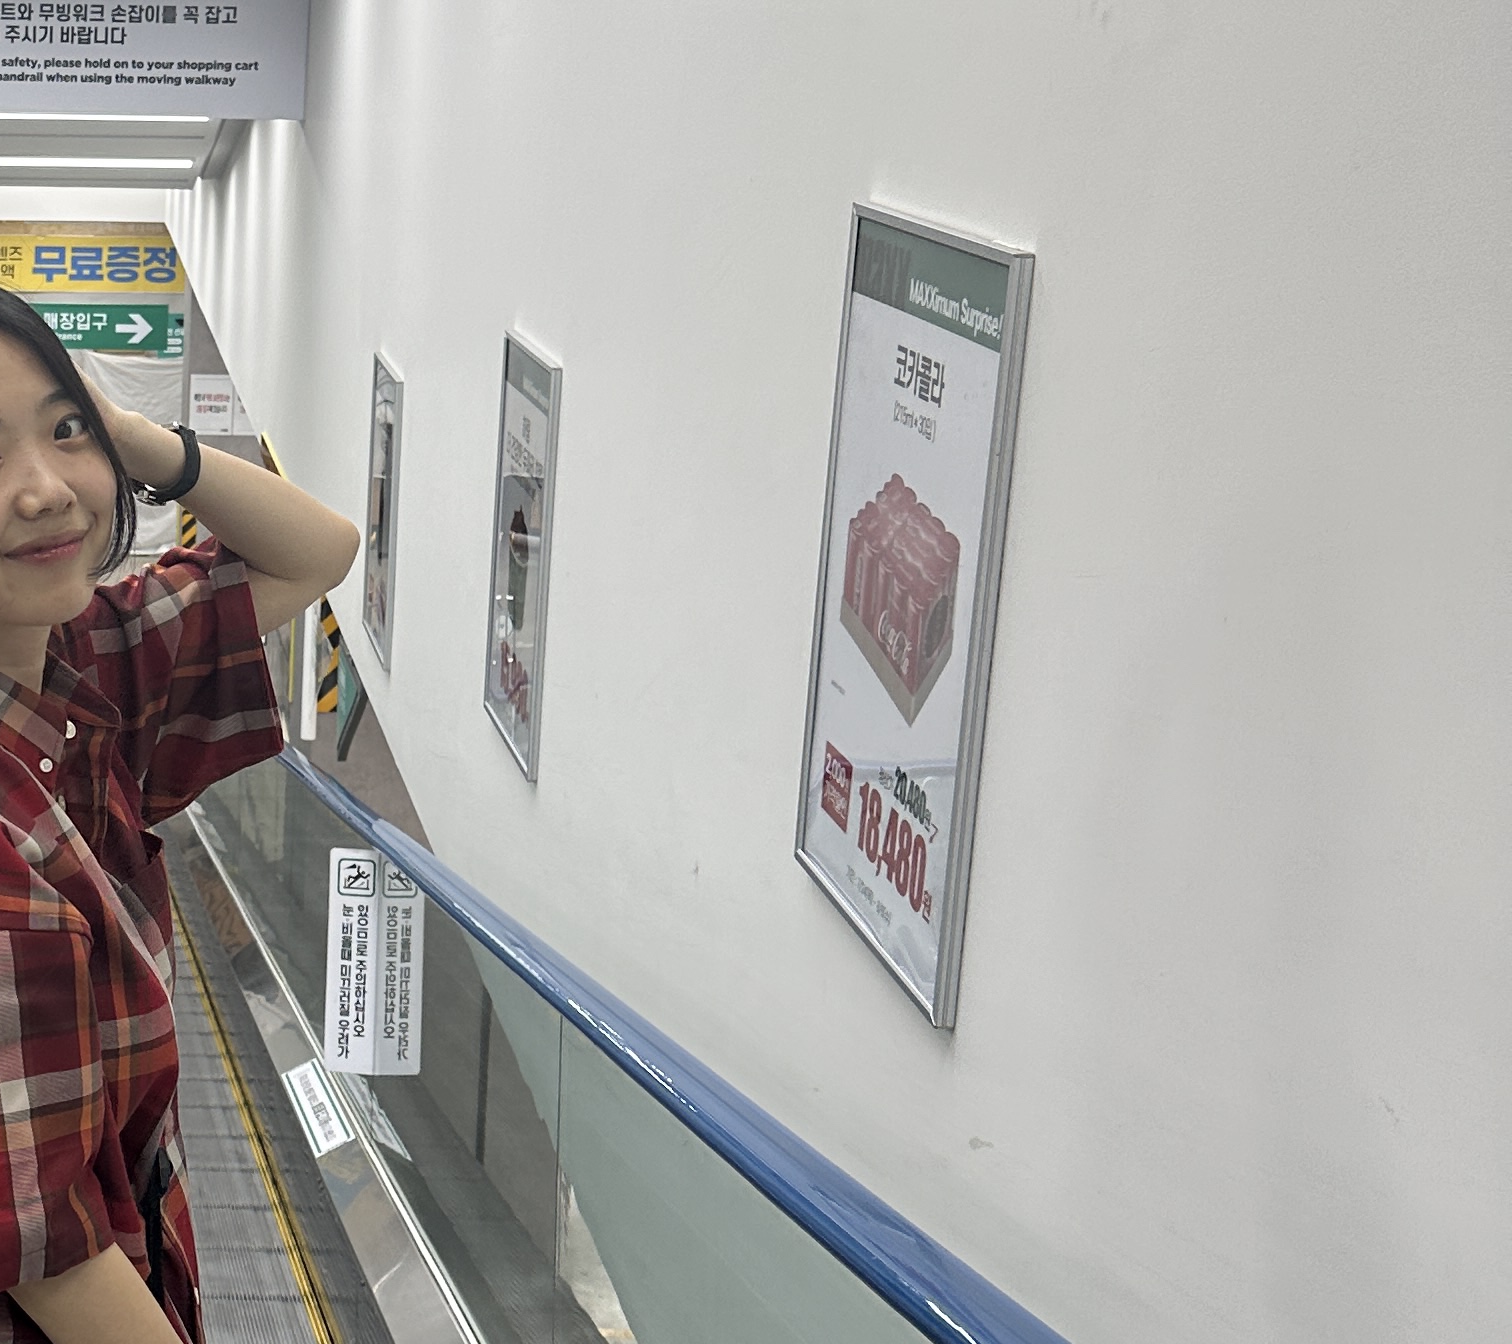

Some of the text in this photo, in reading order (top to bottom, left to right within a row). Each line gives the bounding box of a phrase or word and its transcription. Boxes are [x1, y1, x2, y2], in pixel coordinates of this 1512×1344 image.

[39, 3, 105, 22] 무빙워크
[111, 4, 177, 24] 손잡이를
[183, 6, 199, 24] 꼭
[205, 6, 238, 24] 잡고
[5, 25, 53, 44] 주시기
[60, 25, 127, 45] 바랍니다
[1, 56, 41, 69] safety,
[44, 58, 81, 69] please
[84, 58, 110, 69] hold
[113, 60, 128, 69] on
[132, 59, 144, 69] to
[146, 61, 174, 71] your
[177, 60, 232, 72] shopping
[235, 61, 259, 71] cart
[46, 73, 77, 83] when
[80, 73, 112, 85] using
[115, 73, 134, 83] the
[138, 74, 182, 86] moving
[184, 75, 236, 87] walkway
[32, 245, 177, 283] 무료증정
[909, 277, 960, 321] MAXXimum
[43, 312, 108, 331] 매장입구
[894, 344, 945, 408] 코카콜라
[858, 781, 933, 924] 18,480원
[353, 904, 369, 1037] 있으므로 주의하십시오
[337, 1019, 350, 1059] 우려가
